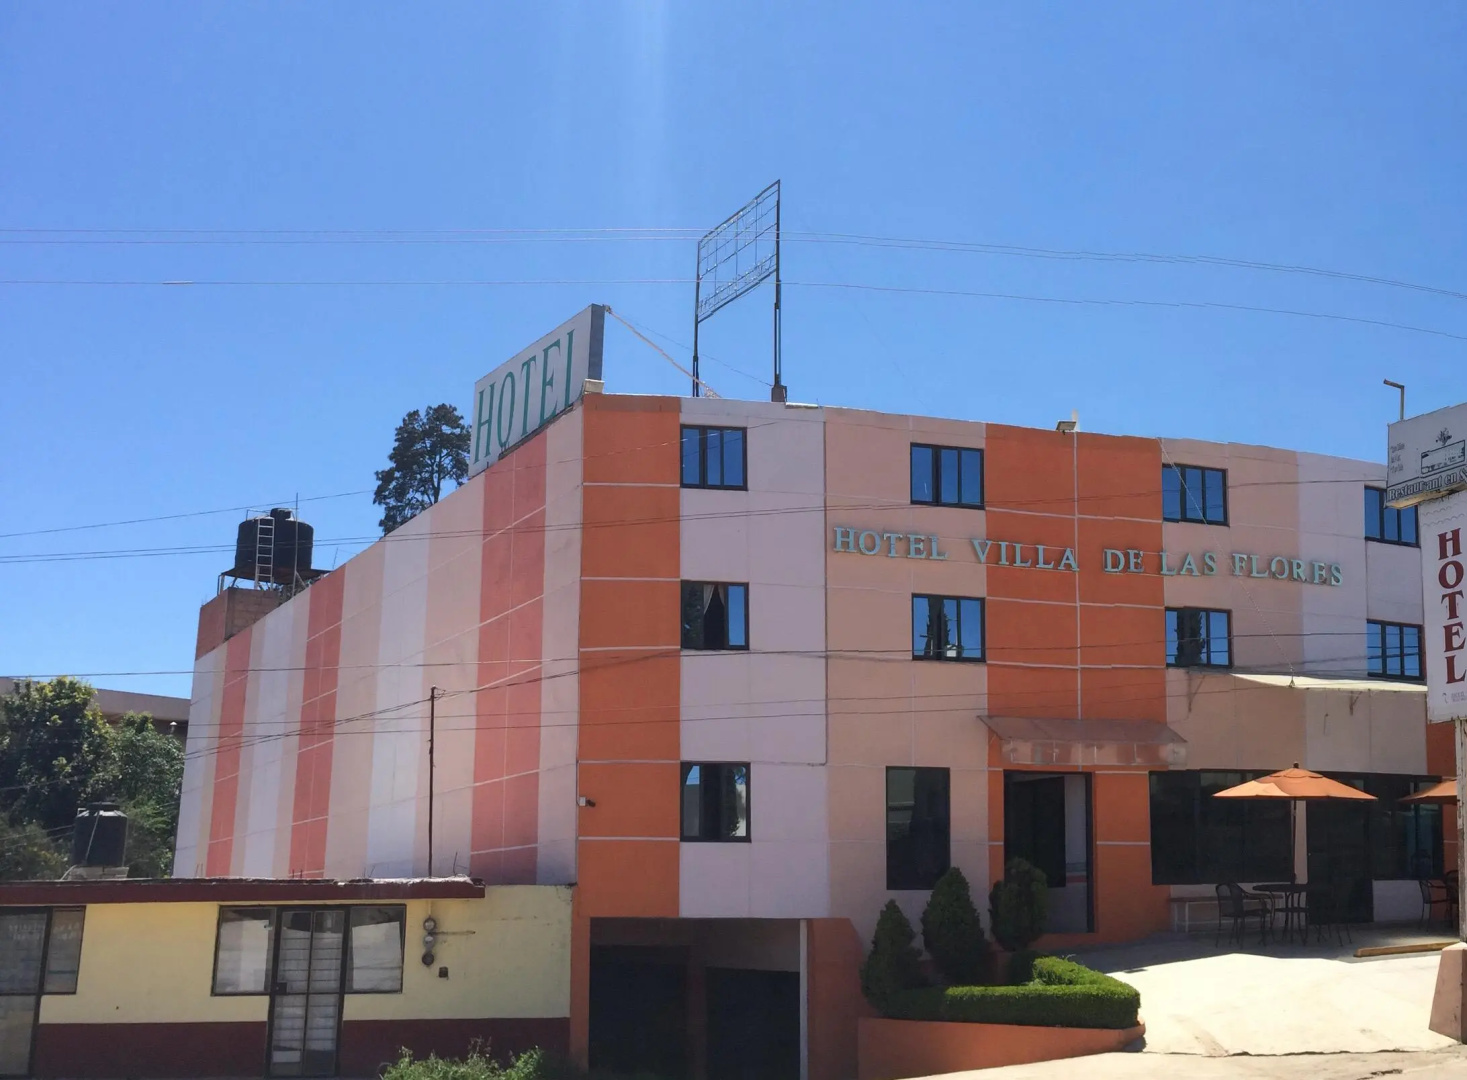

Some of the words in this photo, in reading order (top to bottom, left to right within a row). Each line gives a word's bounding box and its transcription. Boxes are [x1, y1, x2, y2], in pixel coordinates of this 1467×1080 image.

[473, 329, 583, 464] HOTEL
[1388, 476, 1442, 501] Restaurant
[1444, 472, 1458, 484] en
[833, 526, 947, 560] HOTEL
[971, 538, 1080, 571] VILLA
[1103, 549, 1145, 574] DE
[1159, 550, 1218, 577] LAS
[1232, 552, 1344, 587] FLORES
[1437, 527, 1467, 685] HOTEL
